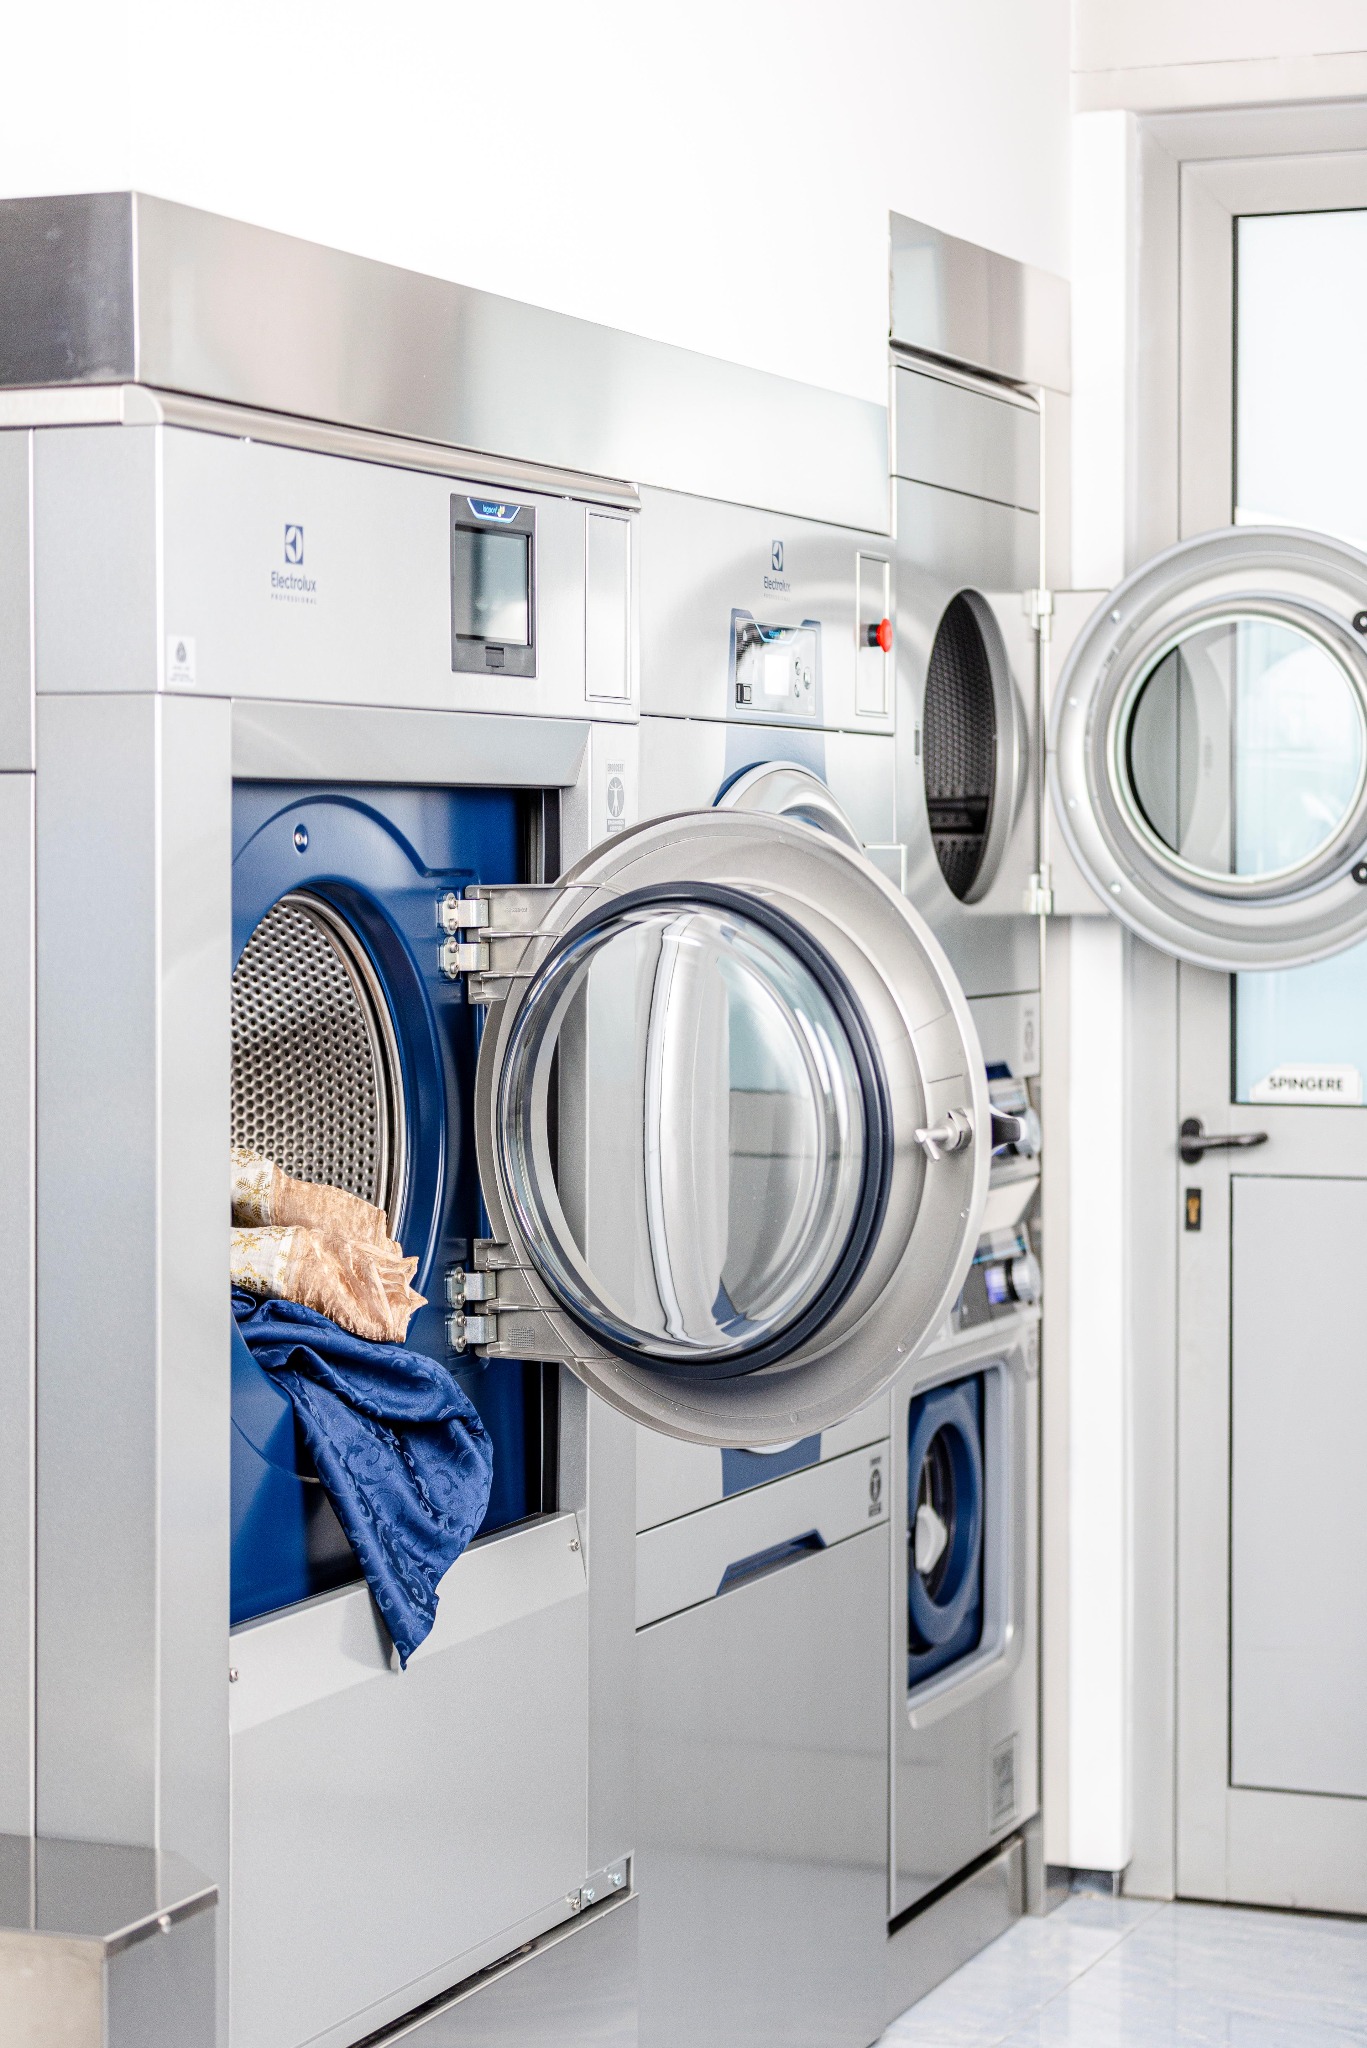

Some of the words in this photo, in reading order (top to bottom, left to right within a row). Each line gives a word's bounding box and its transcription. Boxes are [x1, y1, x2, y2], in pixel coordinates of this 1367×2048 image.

[271, 571, 317, 592] Electrolux
[763, 576, 791, 592] Electrolux
[1269, 1076, 1344, 1092] SPINGERE
